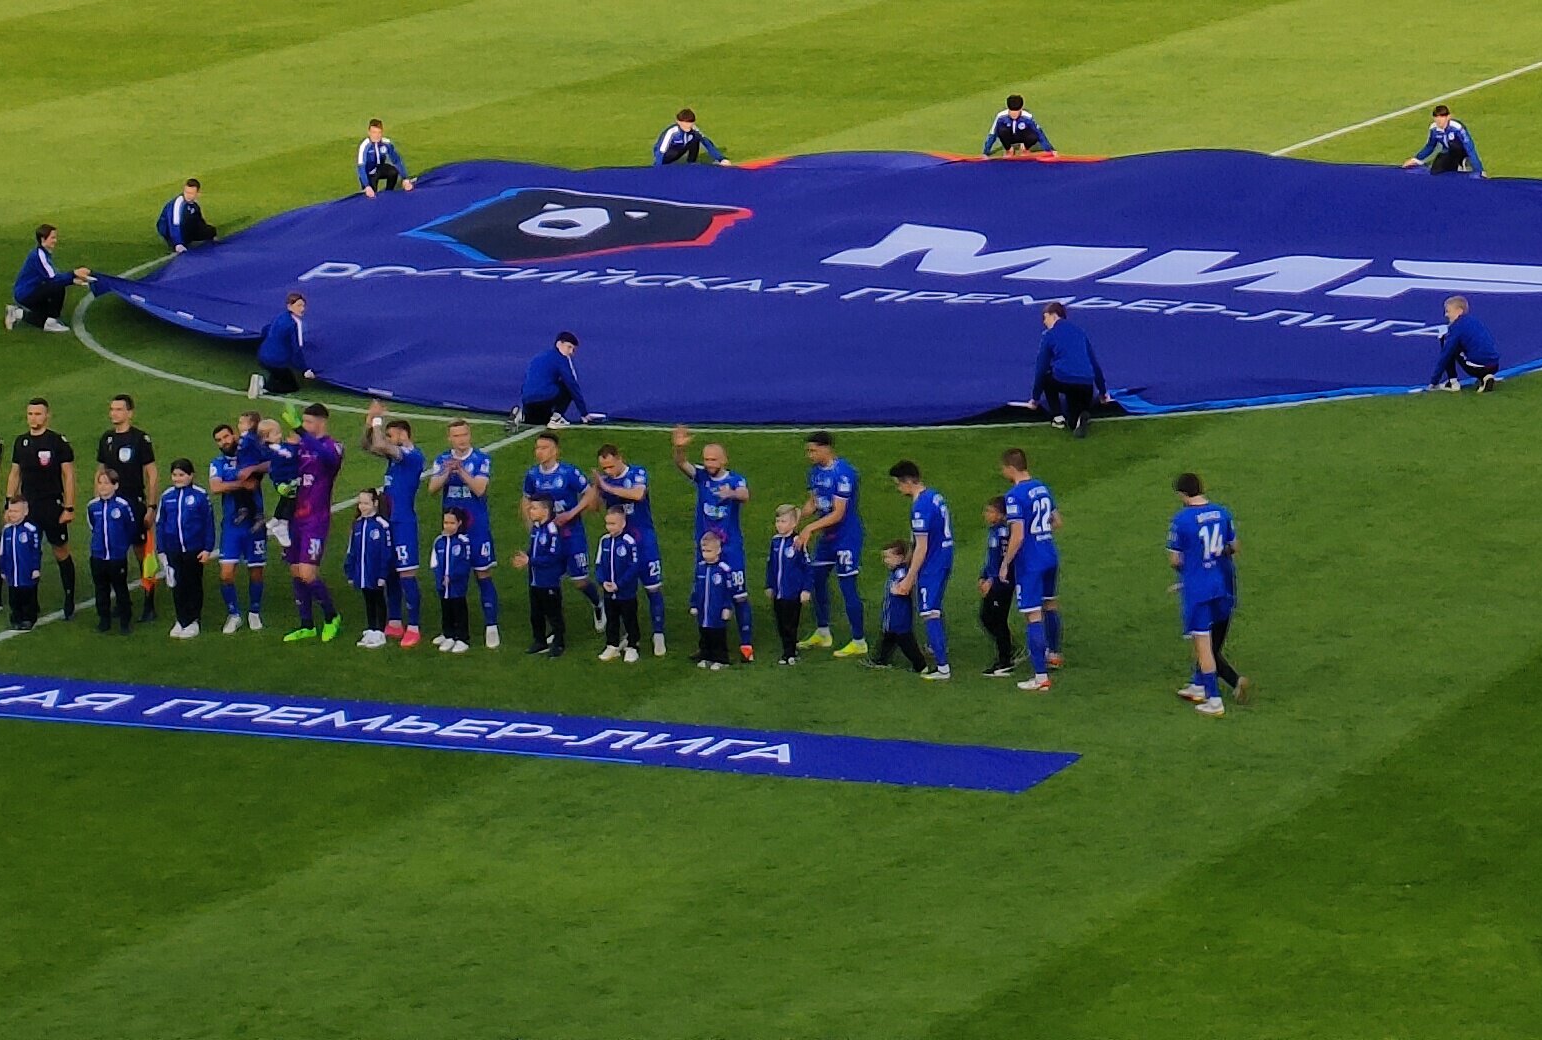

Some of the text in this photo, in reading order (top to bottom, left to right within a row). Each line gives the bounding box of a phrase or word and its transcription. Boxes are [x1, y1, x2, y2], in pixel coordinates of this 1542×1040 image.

[839, 286, 1448, 337] ПРЕМЬЕР-ЛИГА
[1030, 497, 1052, 535] 22
[837, 550, 853, 565] 72
[1199, 523, 1225, 559] 14
[142, 698, 792, 763] ПРЕМЬЕР-ЛИГА
